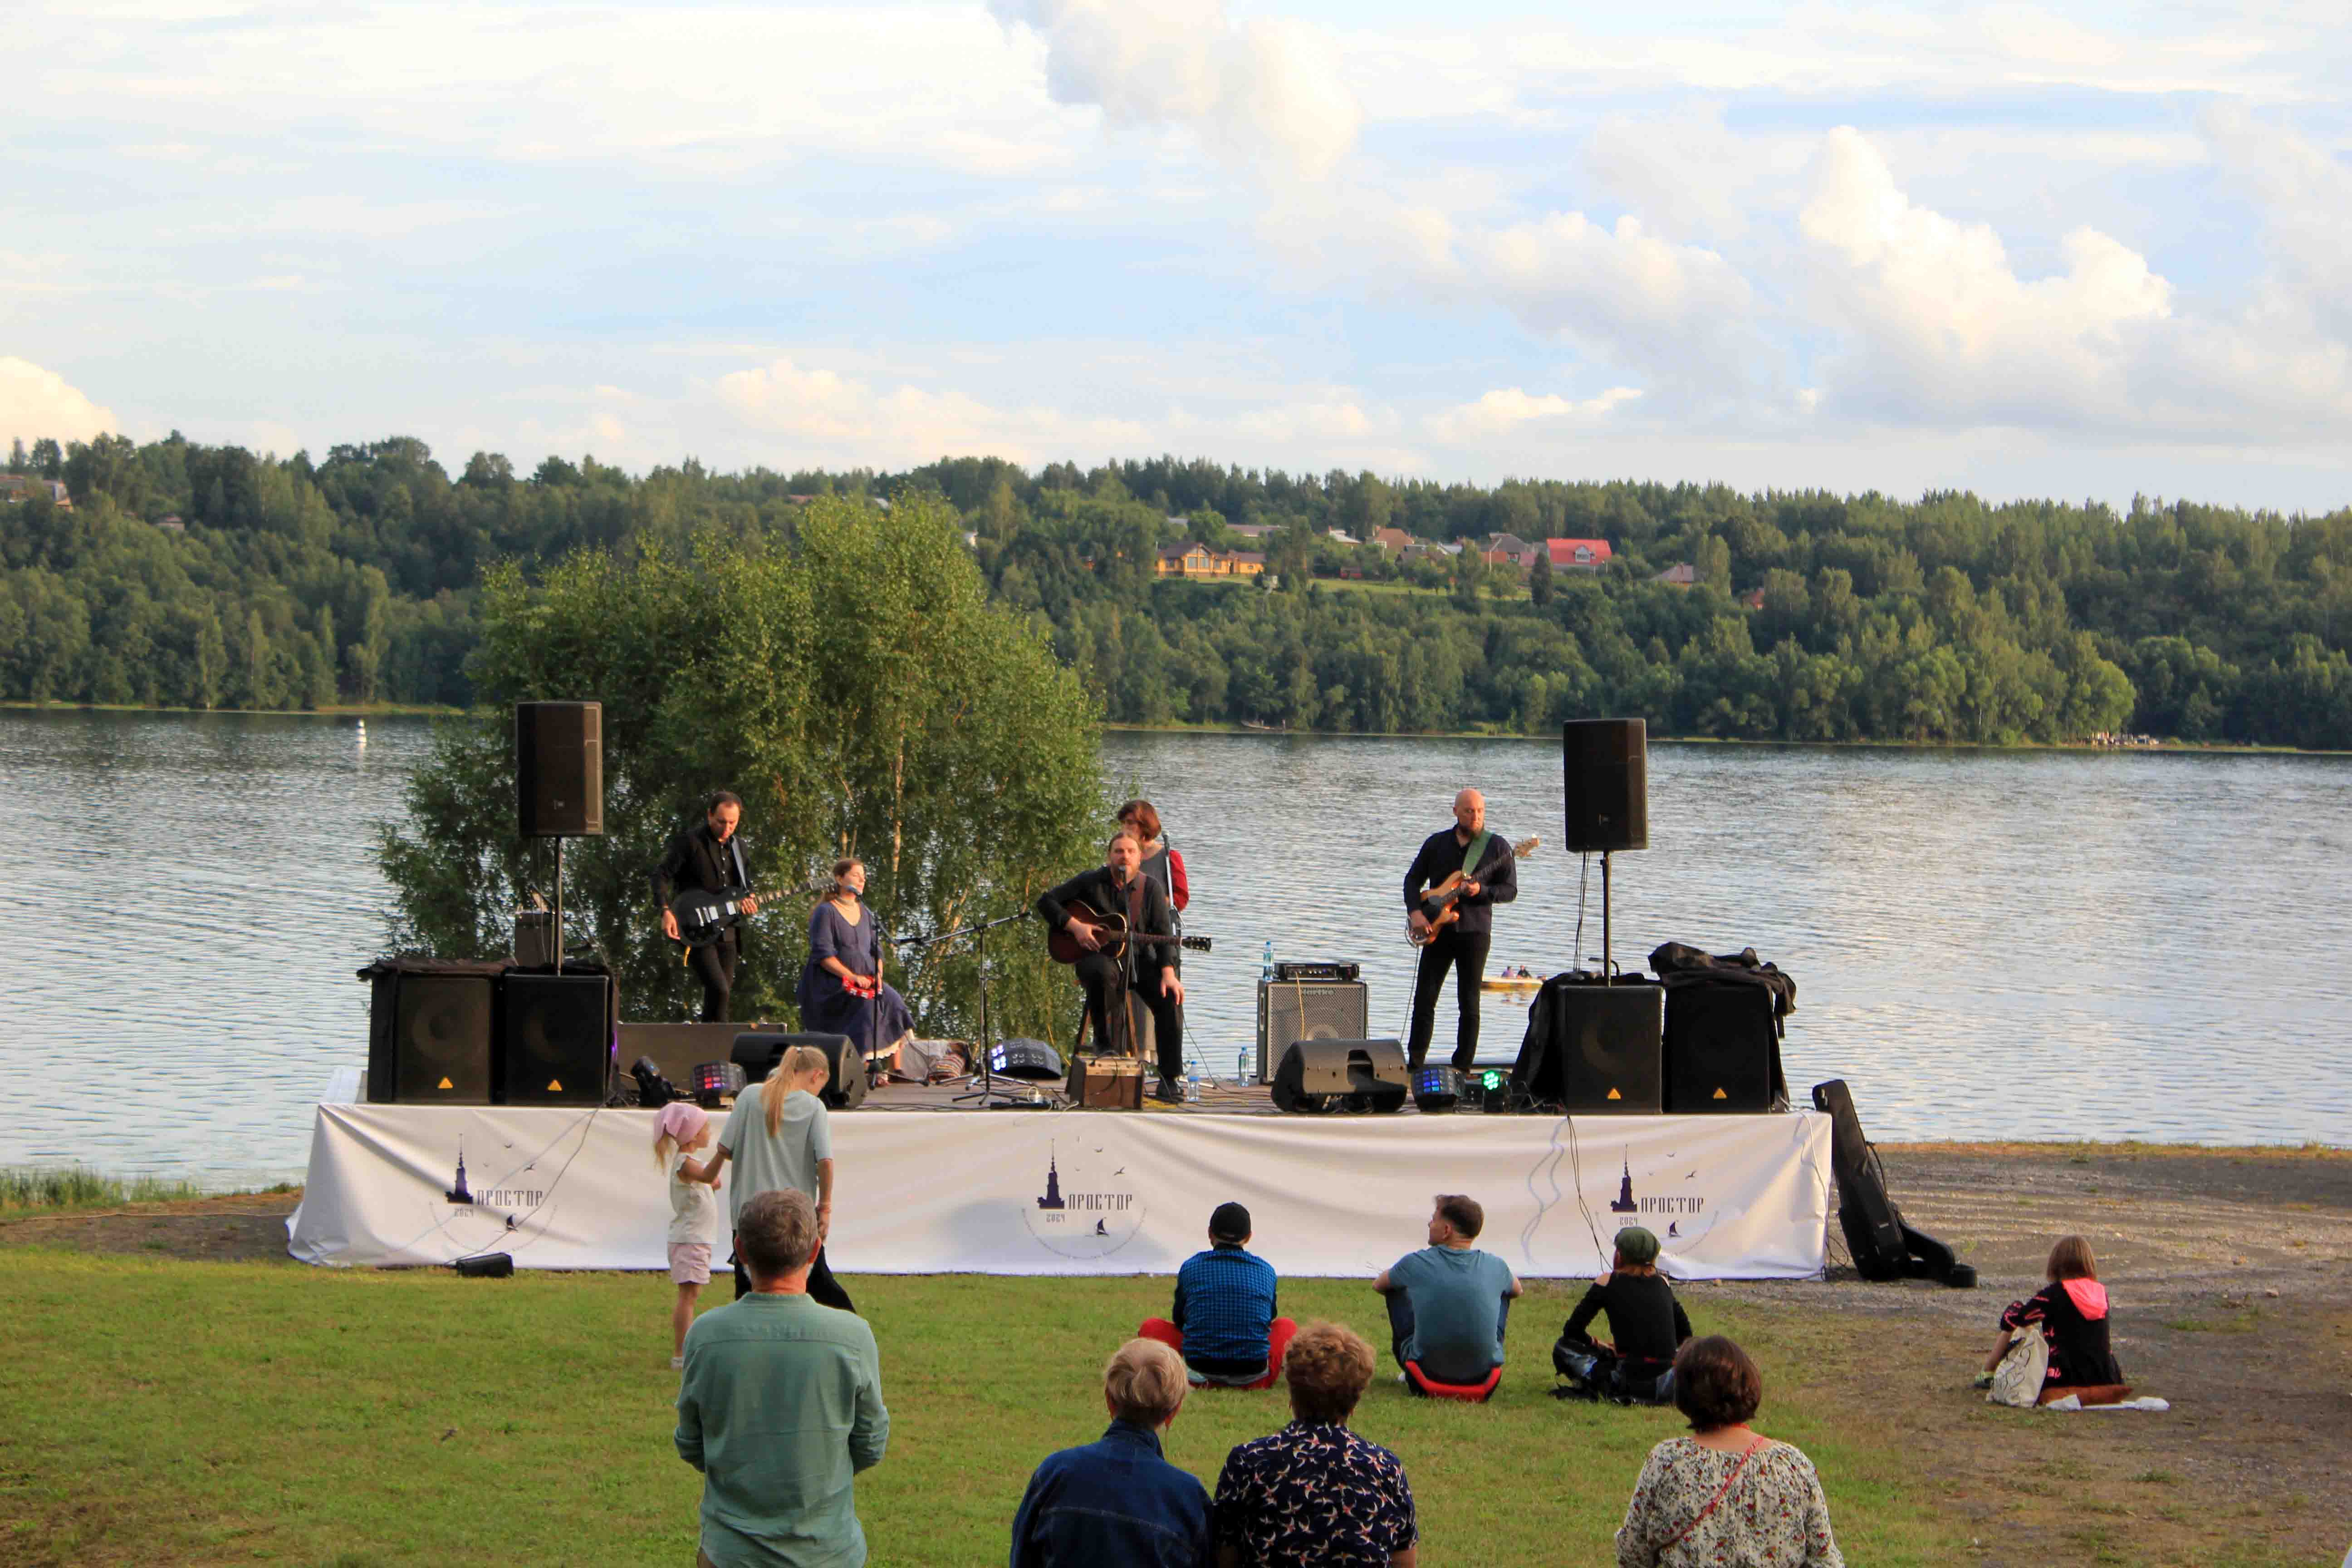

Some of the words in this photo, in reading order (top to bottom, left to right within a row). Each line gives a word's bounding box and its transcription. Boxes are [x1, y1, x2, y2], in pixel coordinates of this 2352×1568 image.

[477, 1190, 543, 1206] ПРОСТОР
[1068, 1194, 1132, 1210] ПРОСТОР
[1641, 1197, 1704, 1213] ПРОСТОР
